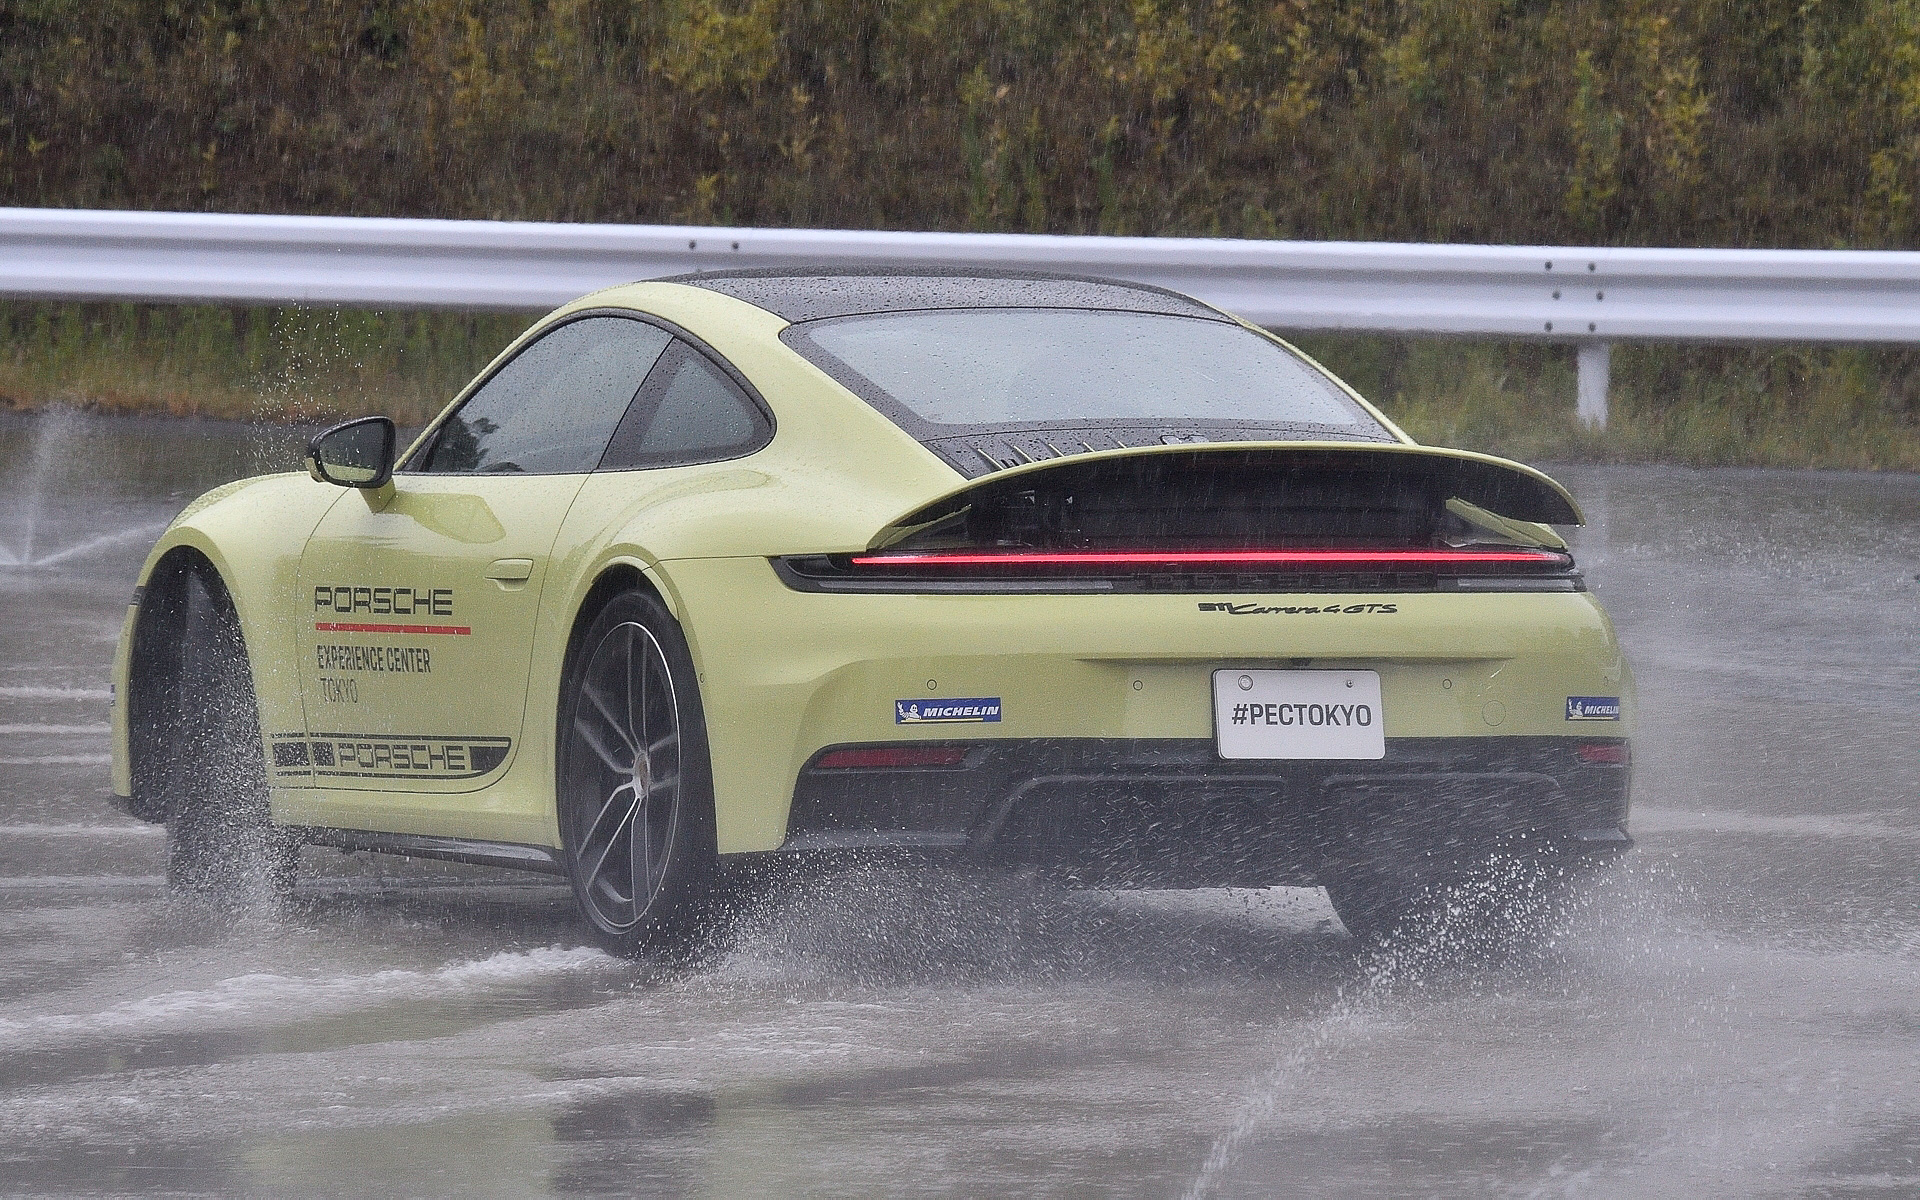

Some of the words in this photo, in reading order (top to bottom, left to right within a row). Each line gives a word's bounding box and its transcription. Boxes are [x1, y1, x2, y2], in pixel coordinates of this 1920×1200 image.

[314, 586, 453, 615] PORSCHE
[1229, 603, 1320, 614] Carrera
[1322, 604, 1341, 613] 4
[1342, 604, 1398, 614] GTS
[317, 645, 384, 672] EXPERIENCE
[386, 648, 431, 673] CENTER
[320, 677, 358, 704] TOKYO
[923, 706, 1000, 717] MICHELIN
[1231, 703, 1372, 726] #PECTOKYO
[338, 742, 465, 770] PORSCHE
